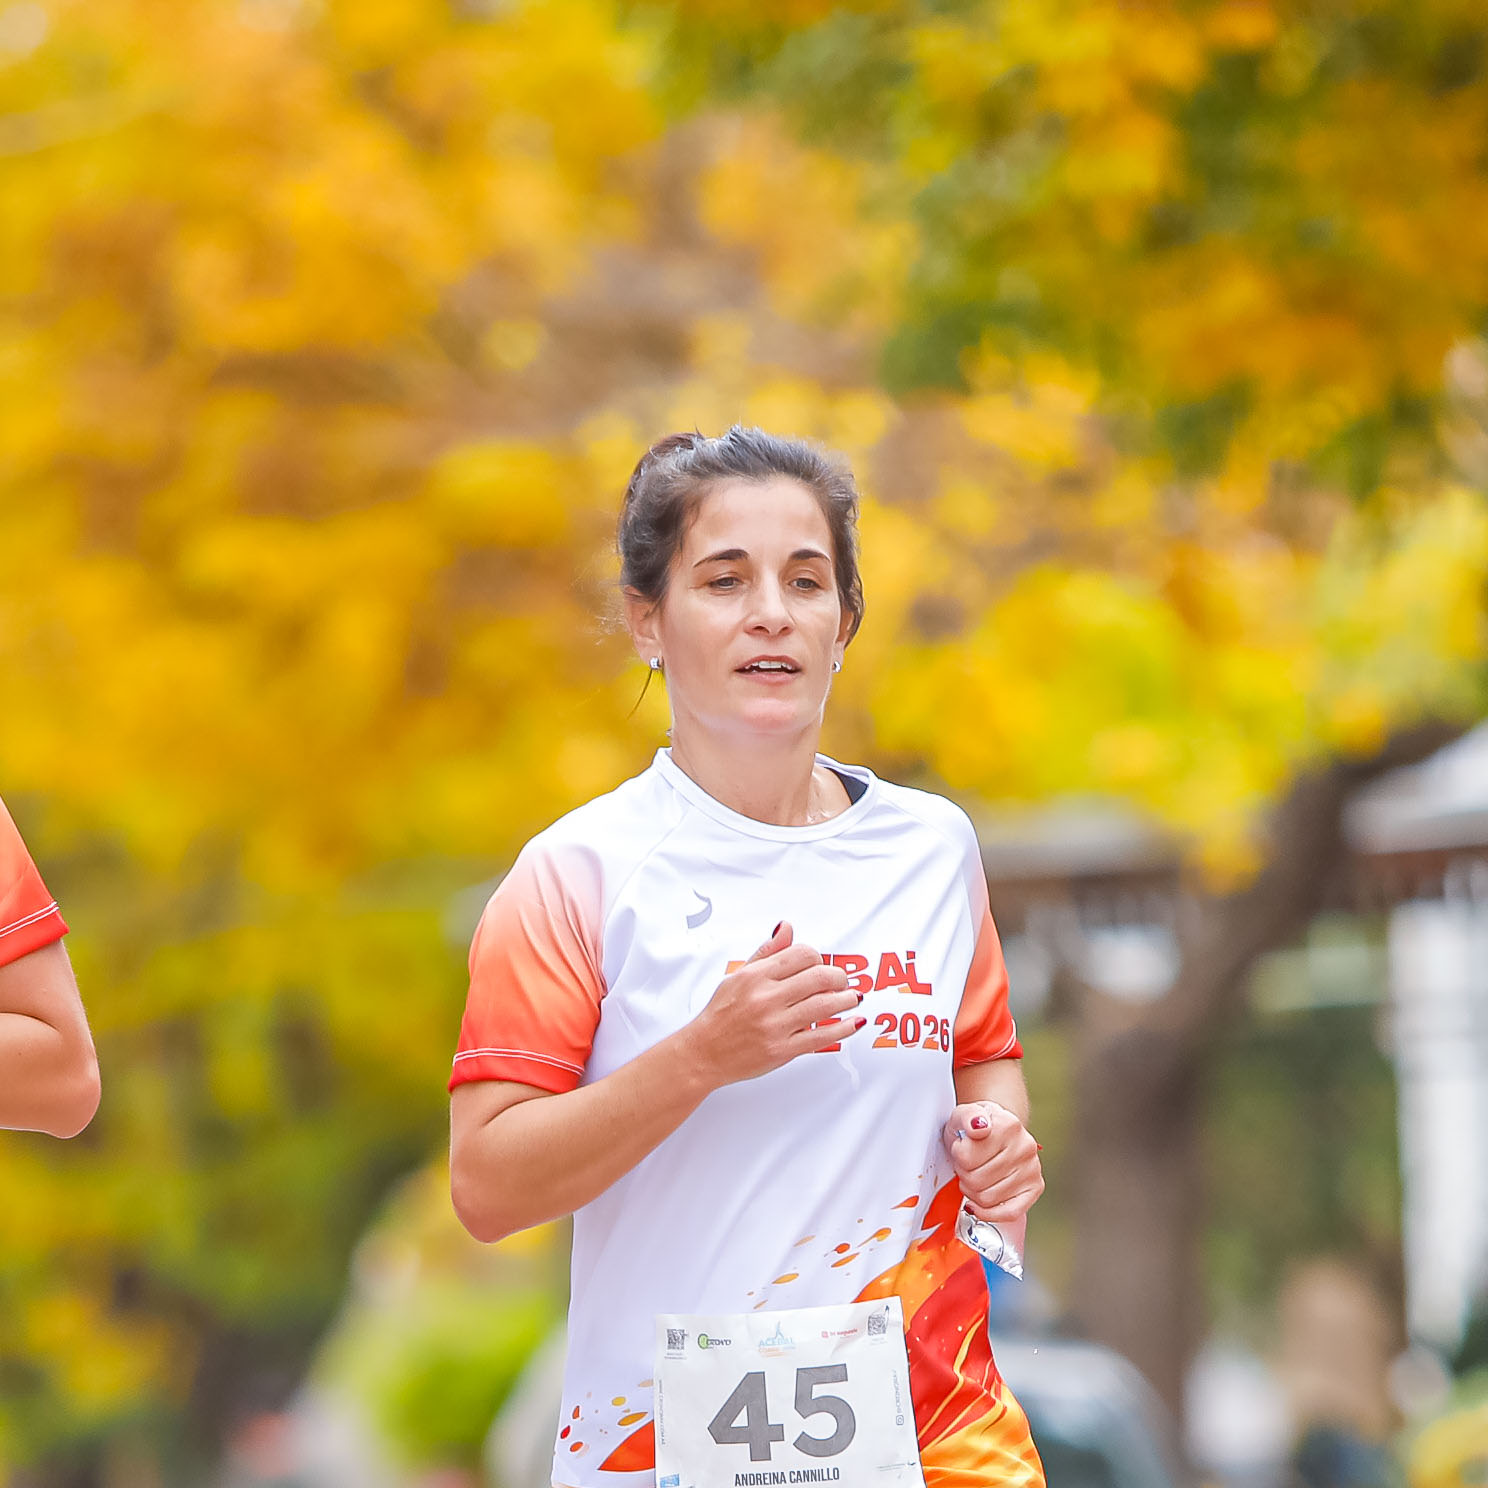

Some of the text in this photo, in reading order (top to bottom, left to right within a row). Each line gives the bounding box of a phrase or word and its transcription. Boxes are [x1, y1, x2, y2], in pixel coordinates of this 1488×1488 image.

[872, 1012, 950, 1052] 2026
[707, 1363, 856, 1462] 45
[734, 1467, 840, 1487] ANDREINA CANNILLO
